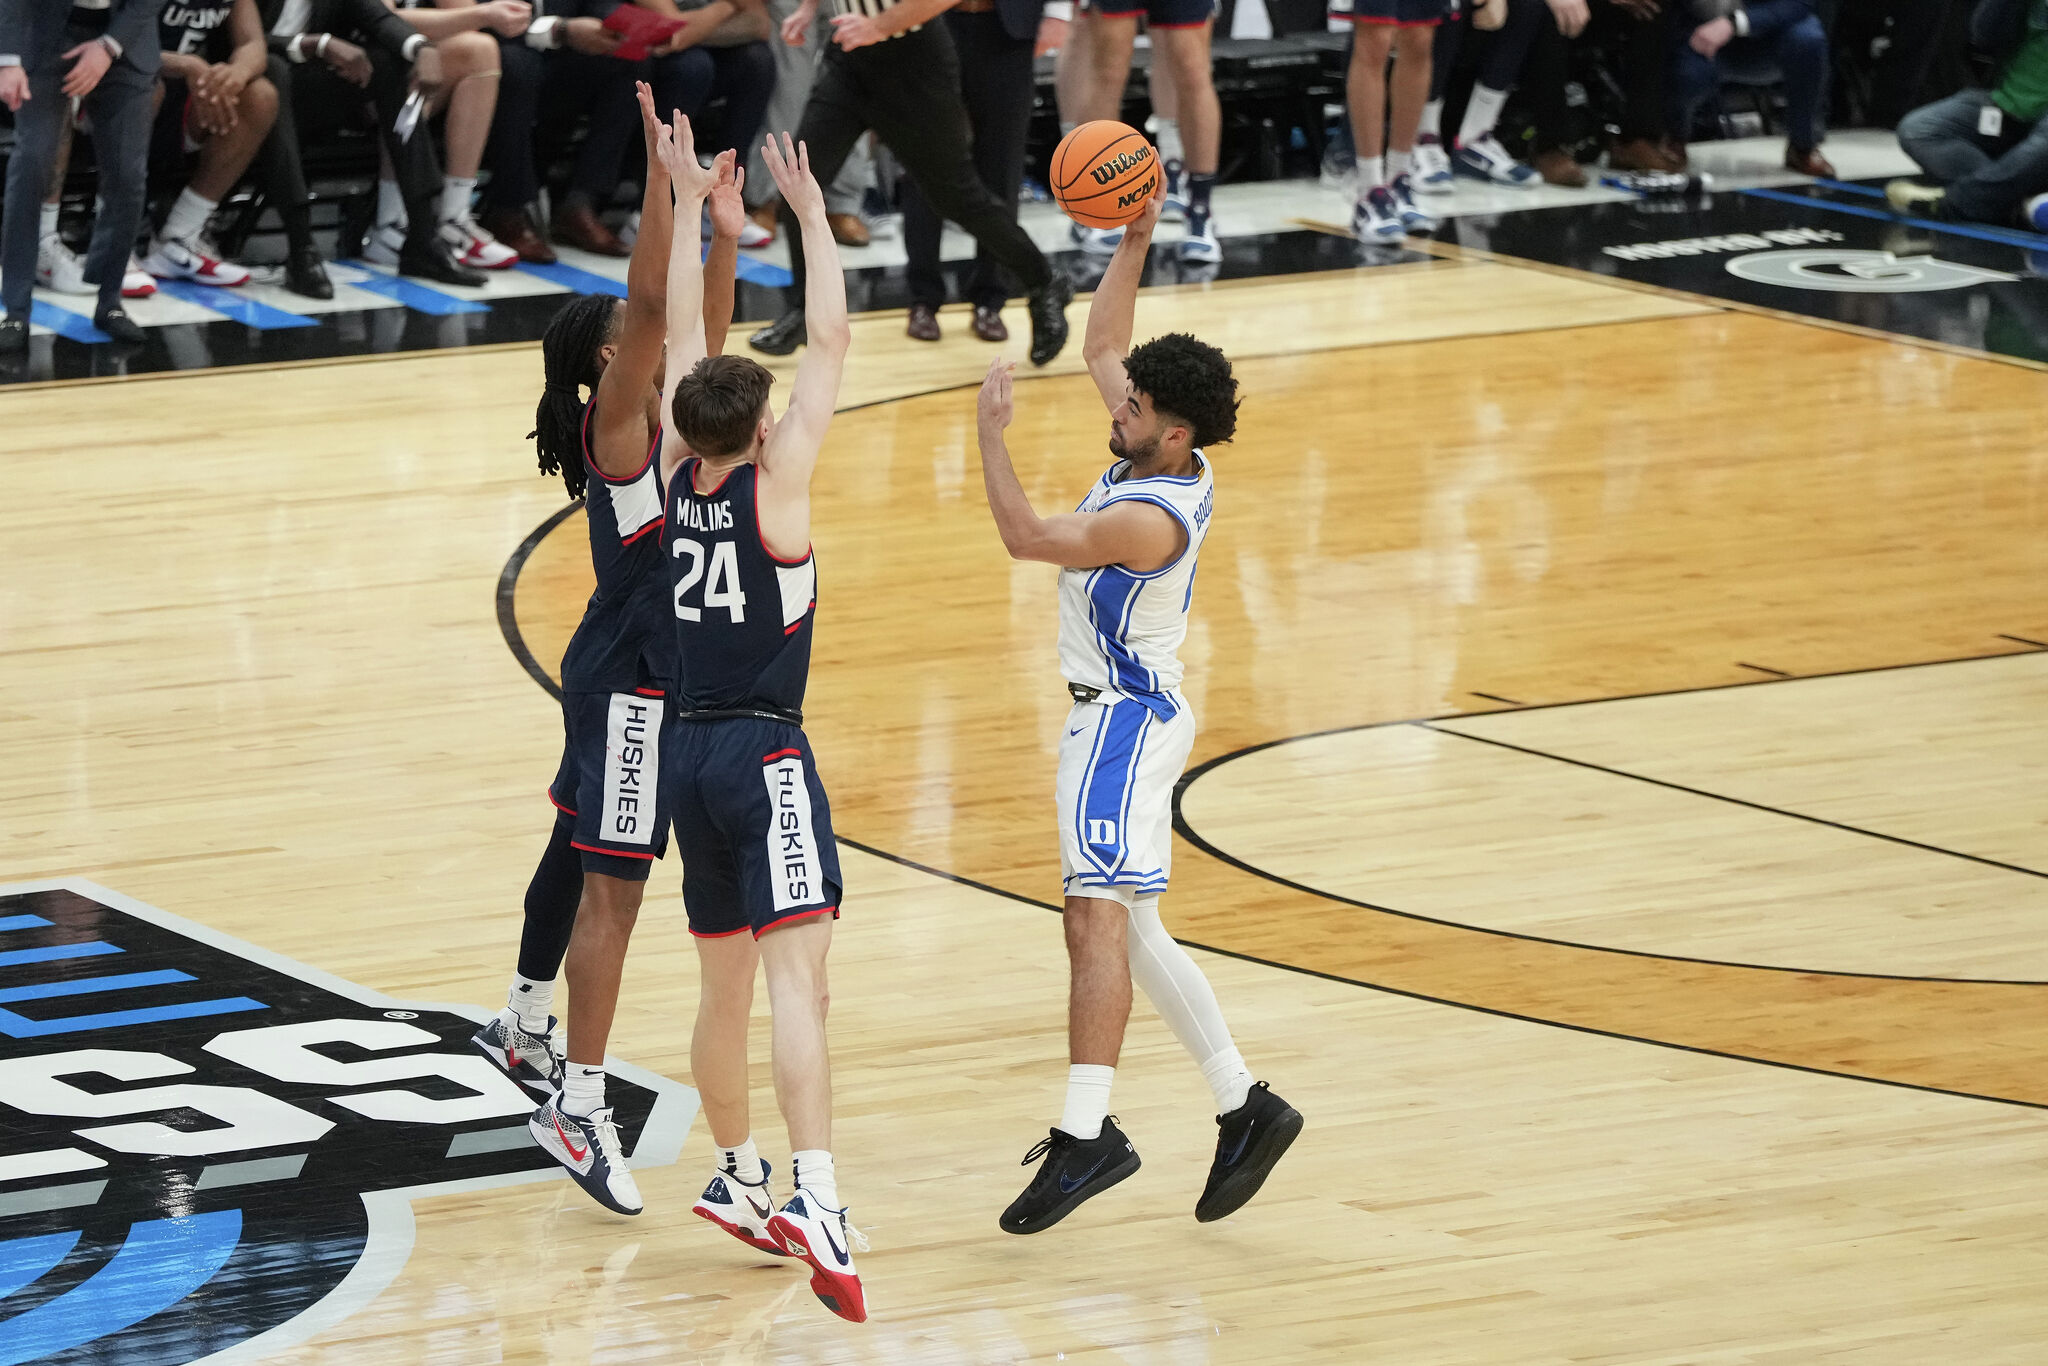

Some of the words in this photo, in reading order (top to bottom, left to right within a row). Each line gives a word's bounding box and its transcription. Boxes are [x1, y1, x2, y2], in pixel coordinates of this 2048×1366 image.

[1089, 145, 1151, 185] Wilson
[1117, 174, 1156, 209] NCAA
[672, 537, 747, 624] 24
[616, 704, 647, 835] HUSKIES
[778, 767, 809, 900] HUSKIES
[1087, 818, 1116, 845] D
